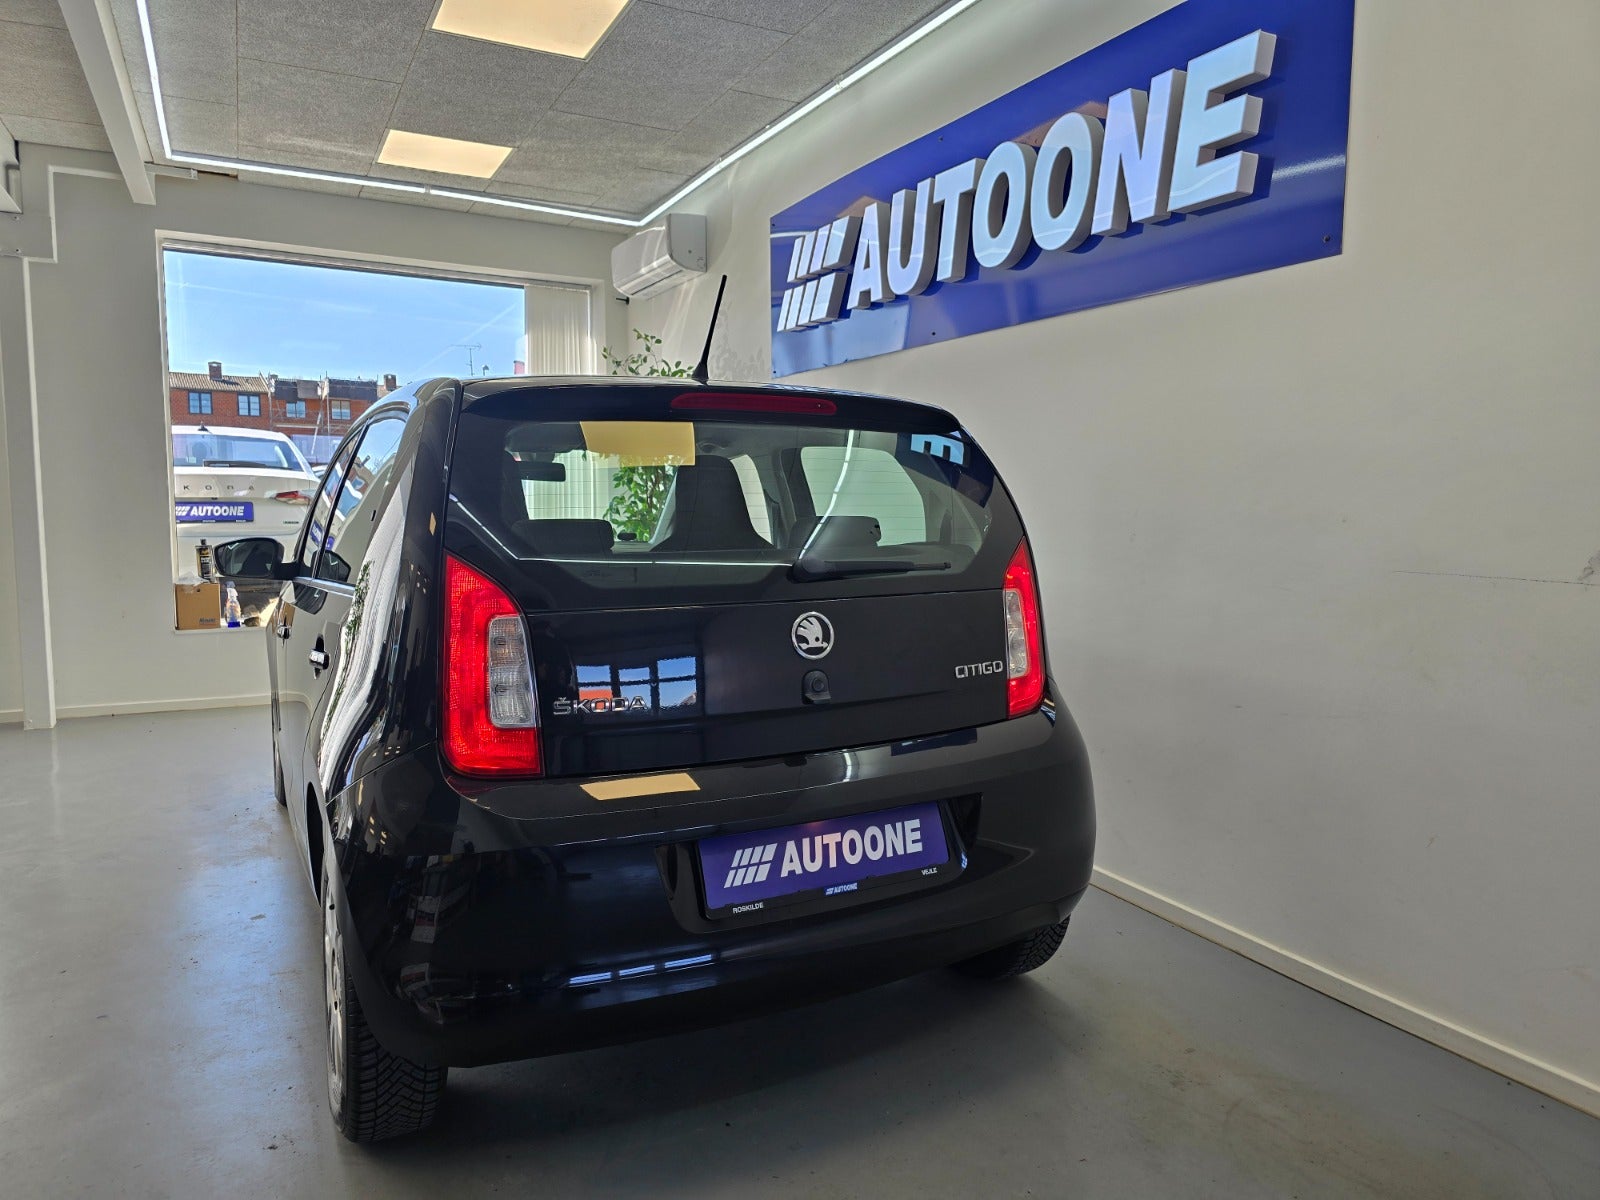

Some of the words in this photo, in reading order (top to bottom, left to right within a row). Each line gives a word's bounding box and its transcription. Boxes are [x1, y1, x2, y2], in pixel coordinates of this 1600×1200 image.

[847, 29, 1276, 310] AUTOONE
[189, 505, 245, 517] AUTOONE
[954, 660, 1004, 679] CITIGO
[553, 695, 649, 716] ŠKODA
[780, 818, 923, 878] AUTOONE
[833, 882, 858, 895] AUTOONE
[732, 901, 764, 914] ROSKILDE
